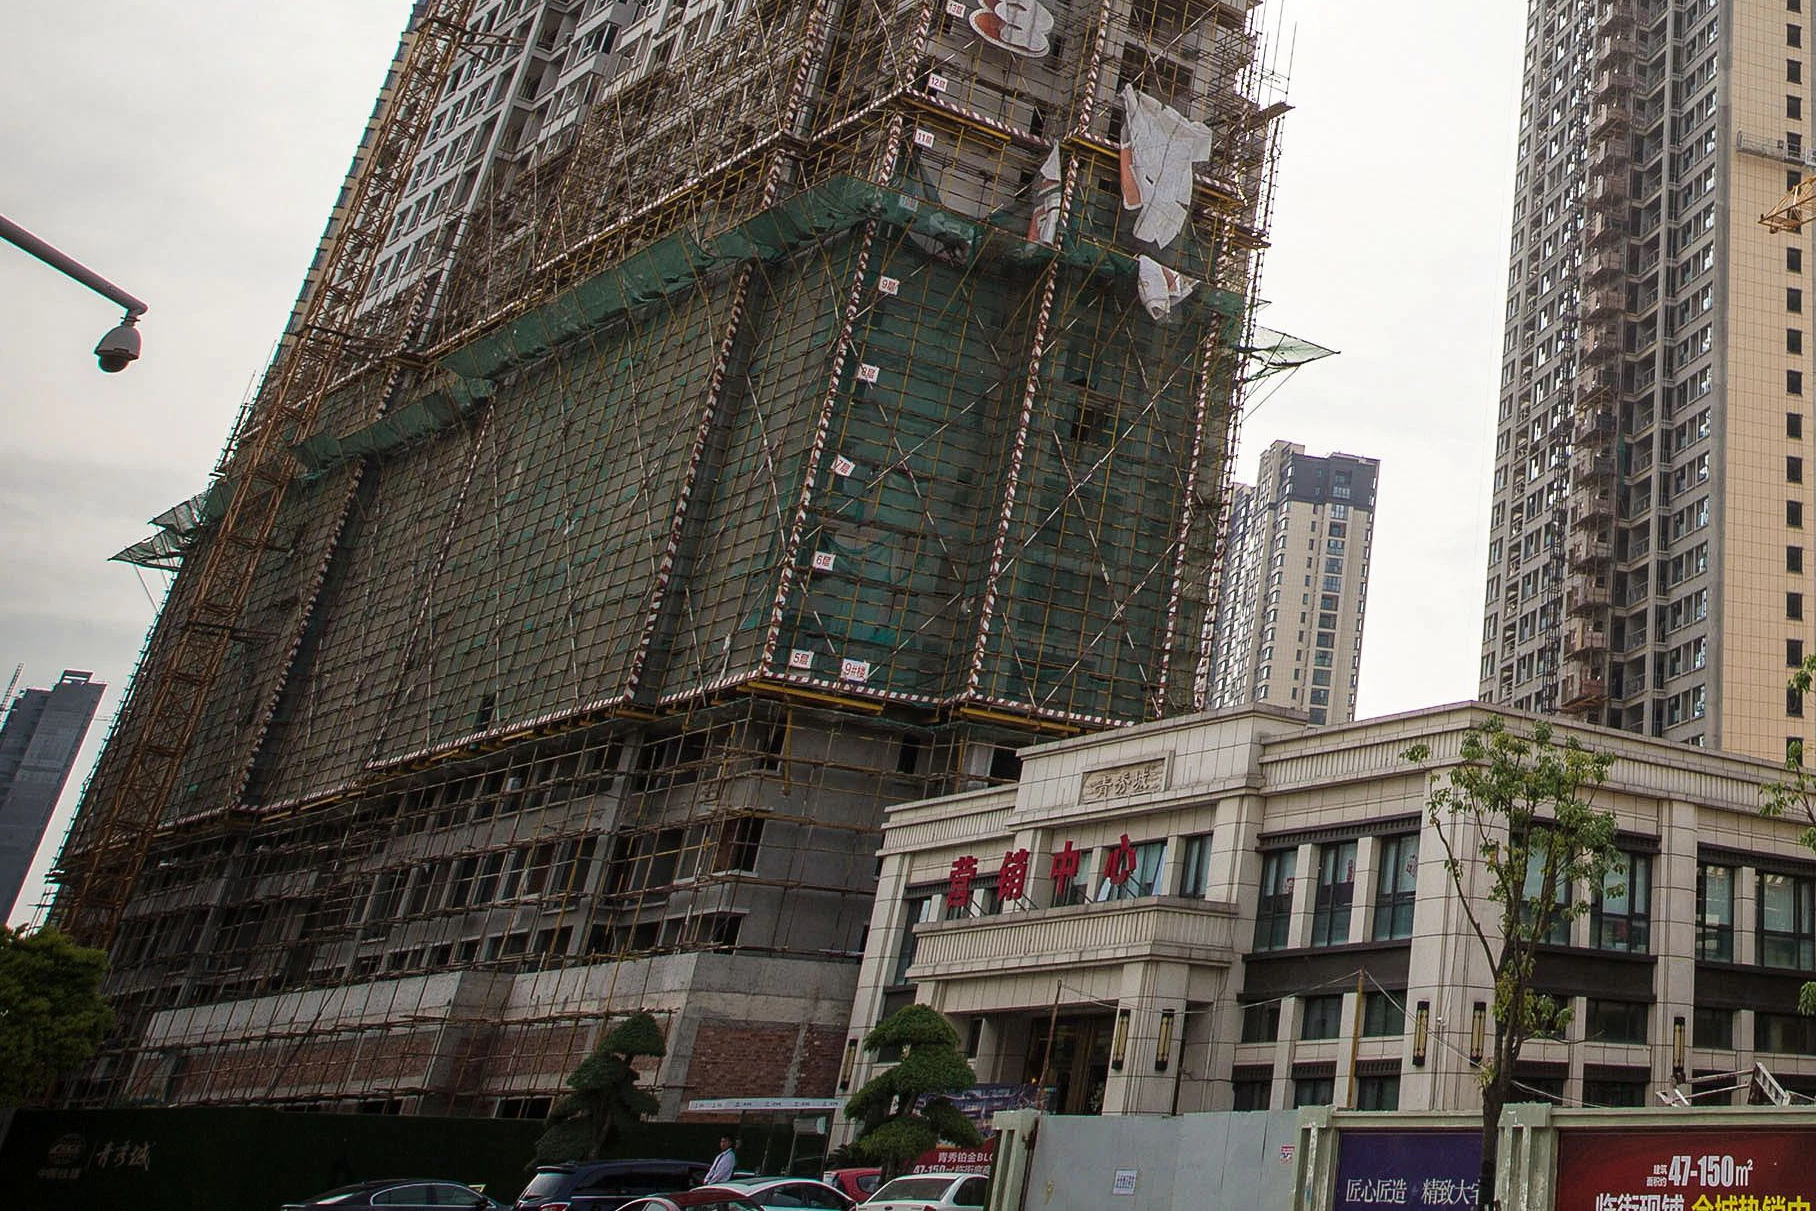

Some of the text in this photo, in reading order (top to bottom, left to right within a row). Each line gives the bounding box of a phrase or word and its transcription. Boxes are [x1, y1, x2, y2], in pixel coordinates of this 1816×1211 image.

[948, 834, 1137, 908] 营销中心
[1345, 1178, 1408, 1204] 匠心匠造
